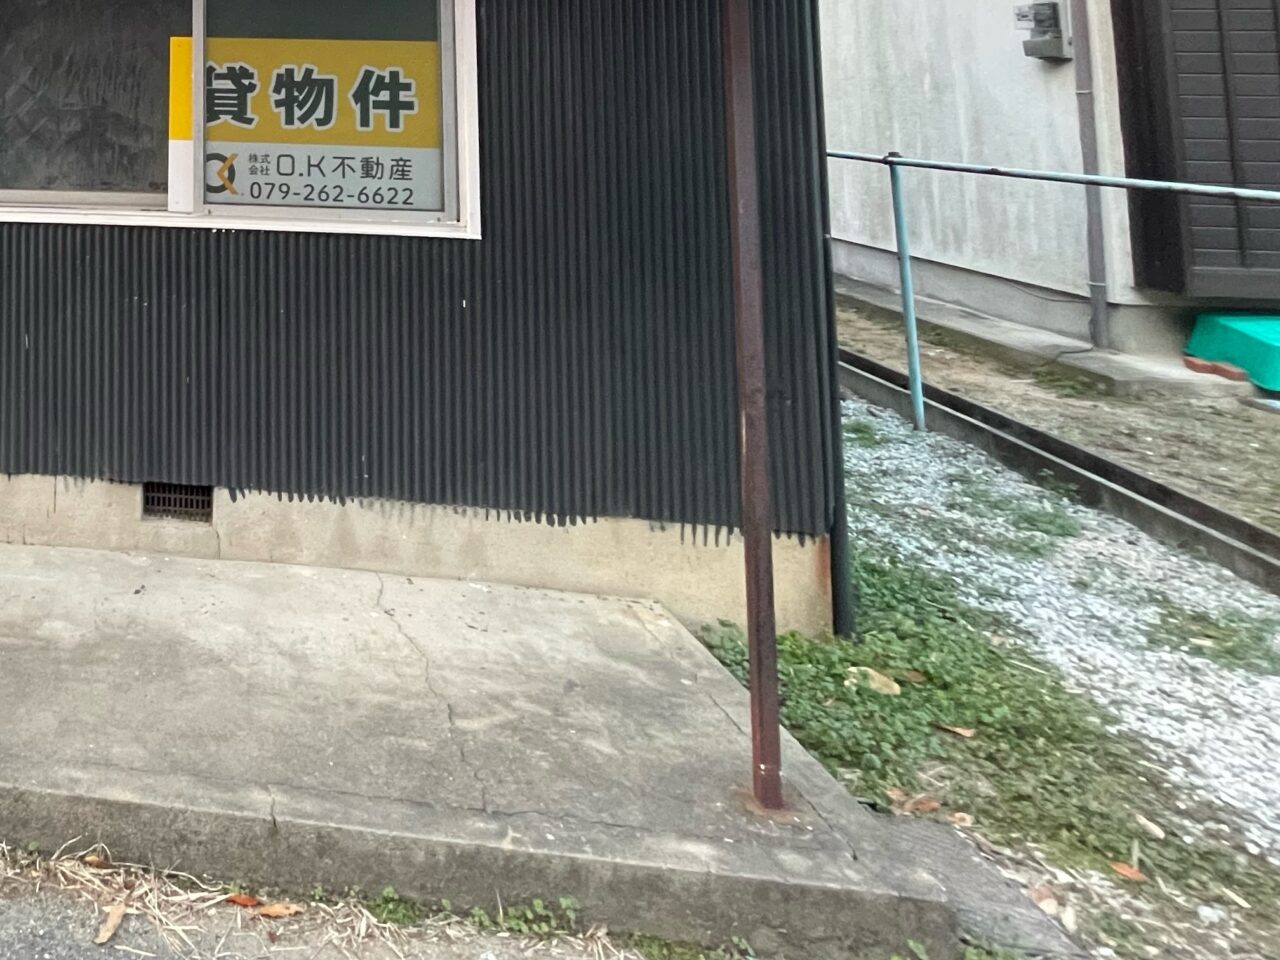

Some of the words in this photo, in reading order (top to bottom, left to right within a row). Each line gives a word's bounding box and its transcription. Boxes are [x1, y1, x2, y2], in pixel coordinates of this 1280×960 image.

[206, 65, 415, 129] 貸物件
[249, 153, 271, 164] 株式
[249, 165, 271, 176] 会社
[276, 154, 413, 181] O.K不動産
[250, 182, 414, 206] 079-262-6622
